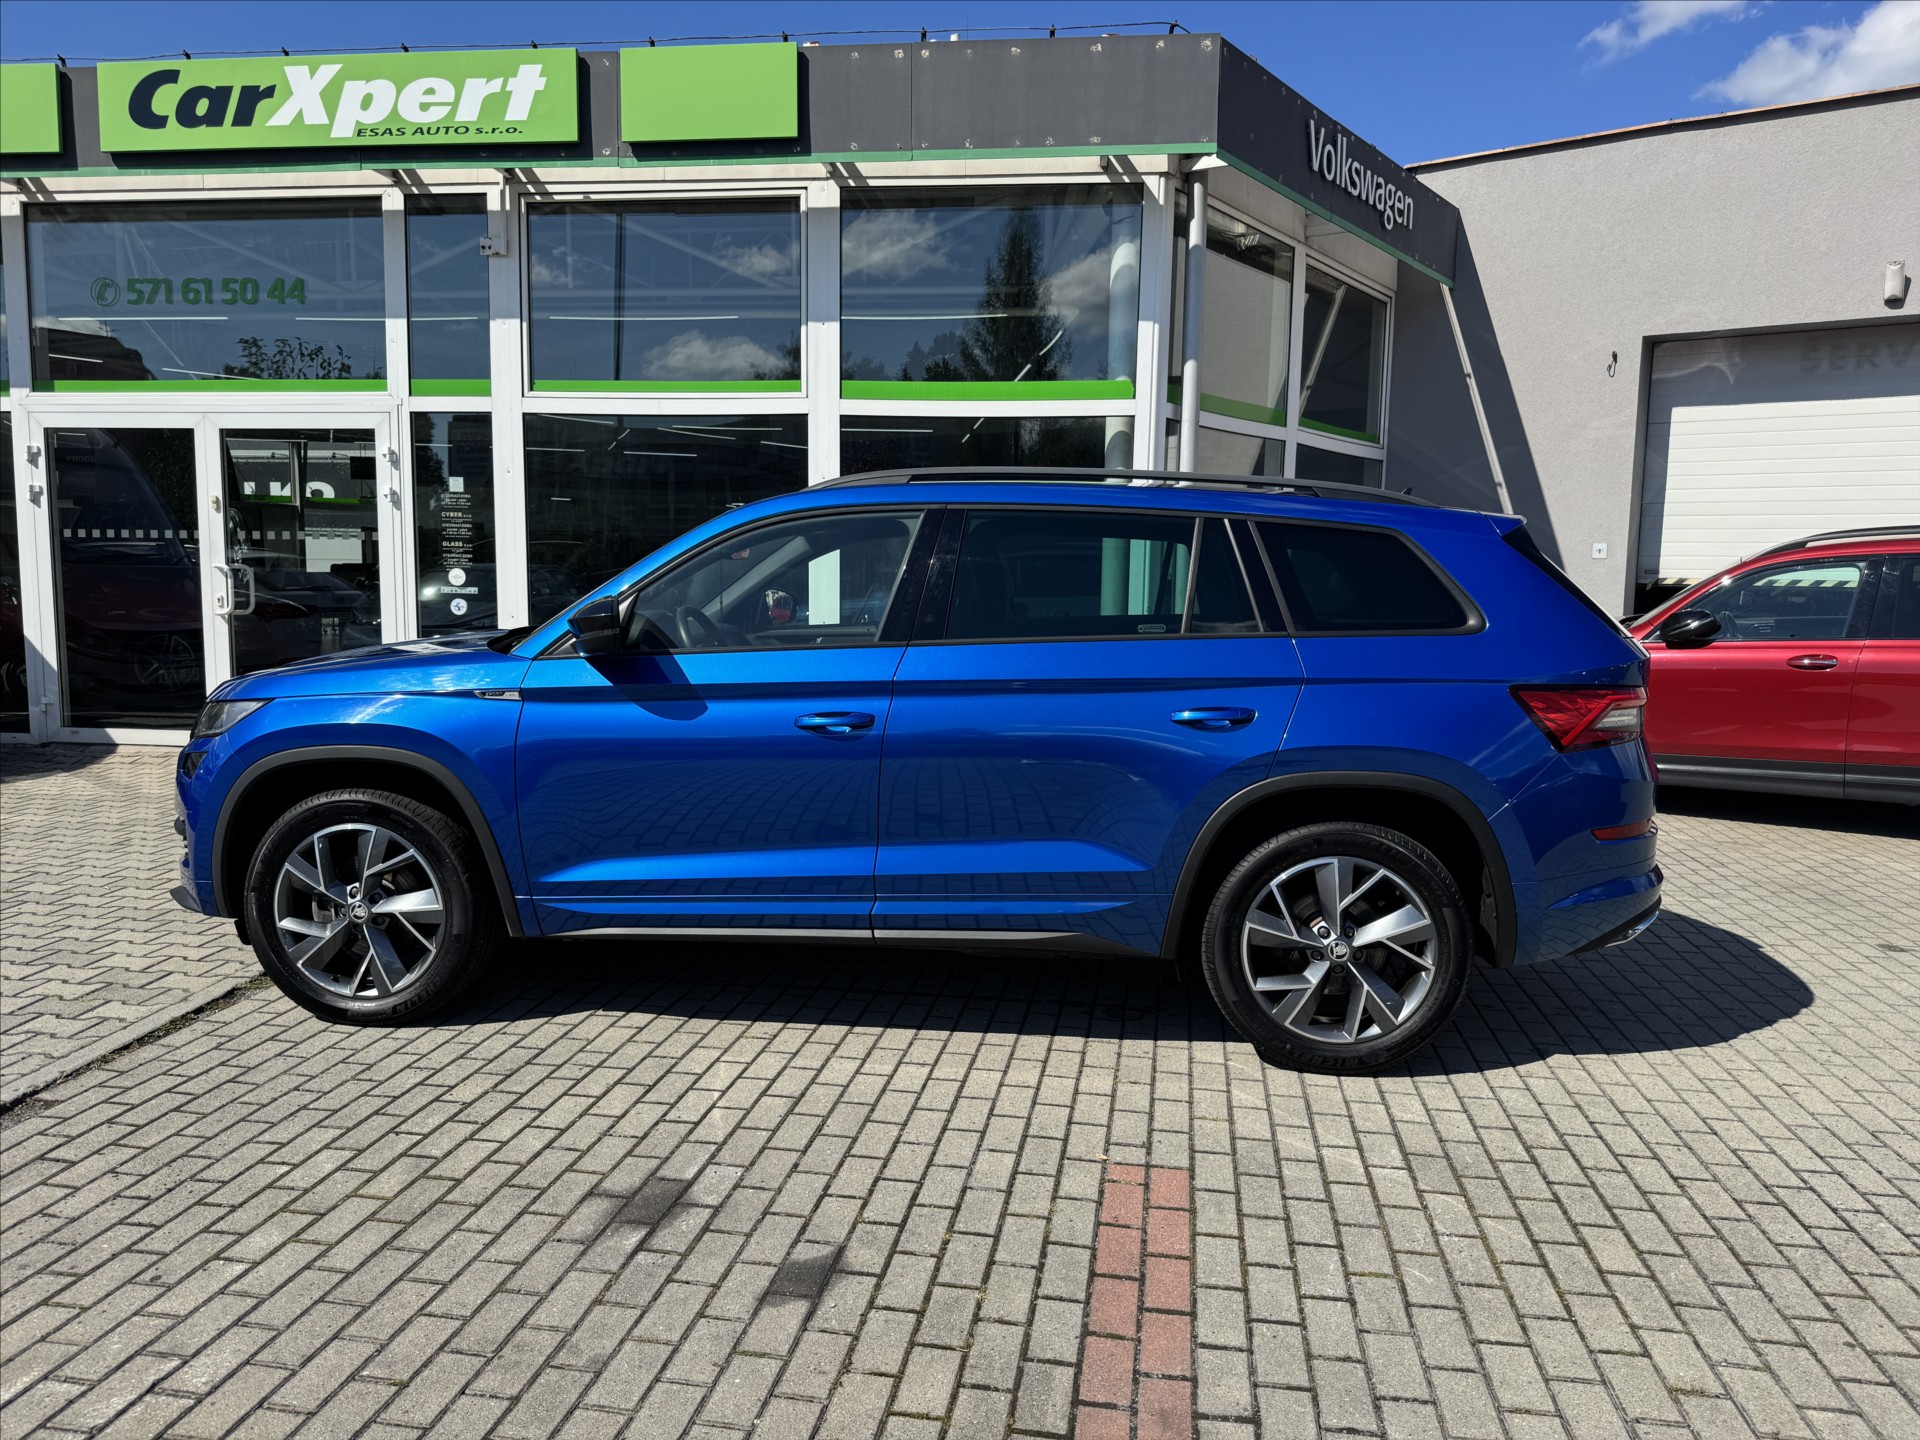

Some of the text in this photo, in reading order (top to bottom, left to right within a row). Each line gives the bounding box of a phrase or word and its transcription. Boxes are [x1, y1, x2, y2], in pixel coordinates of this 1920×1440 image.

[128, 64, 547, 138] CarXpert
[356, 125, 524, 138] ESAS AUTO s.r.o.
[1310, 119, 1414, 230] Volkswagen
[126, 277, 306, 305] 571 61 50 44
